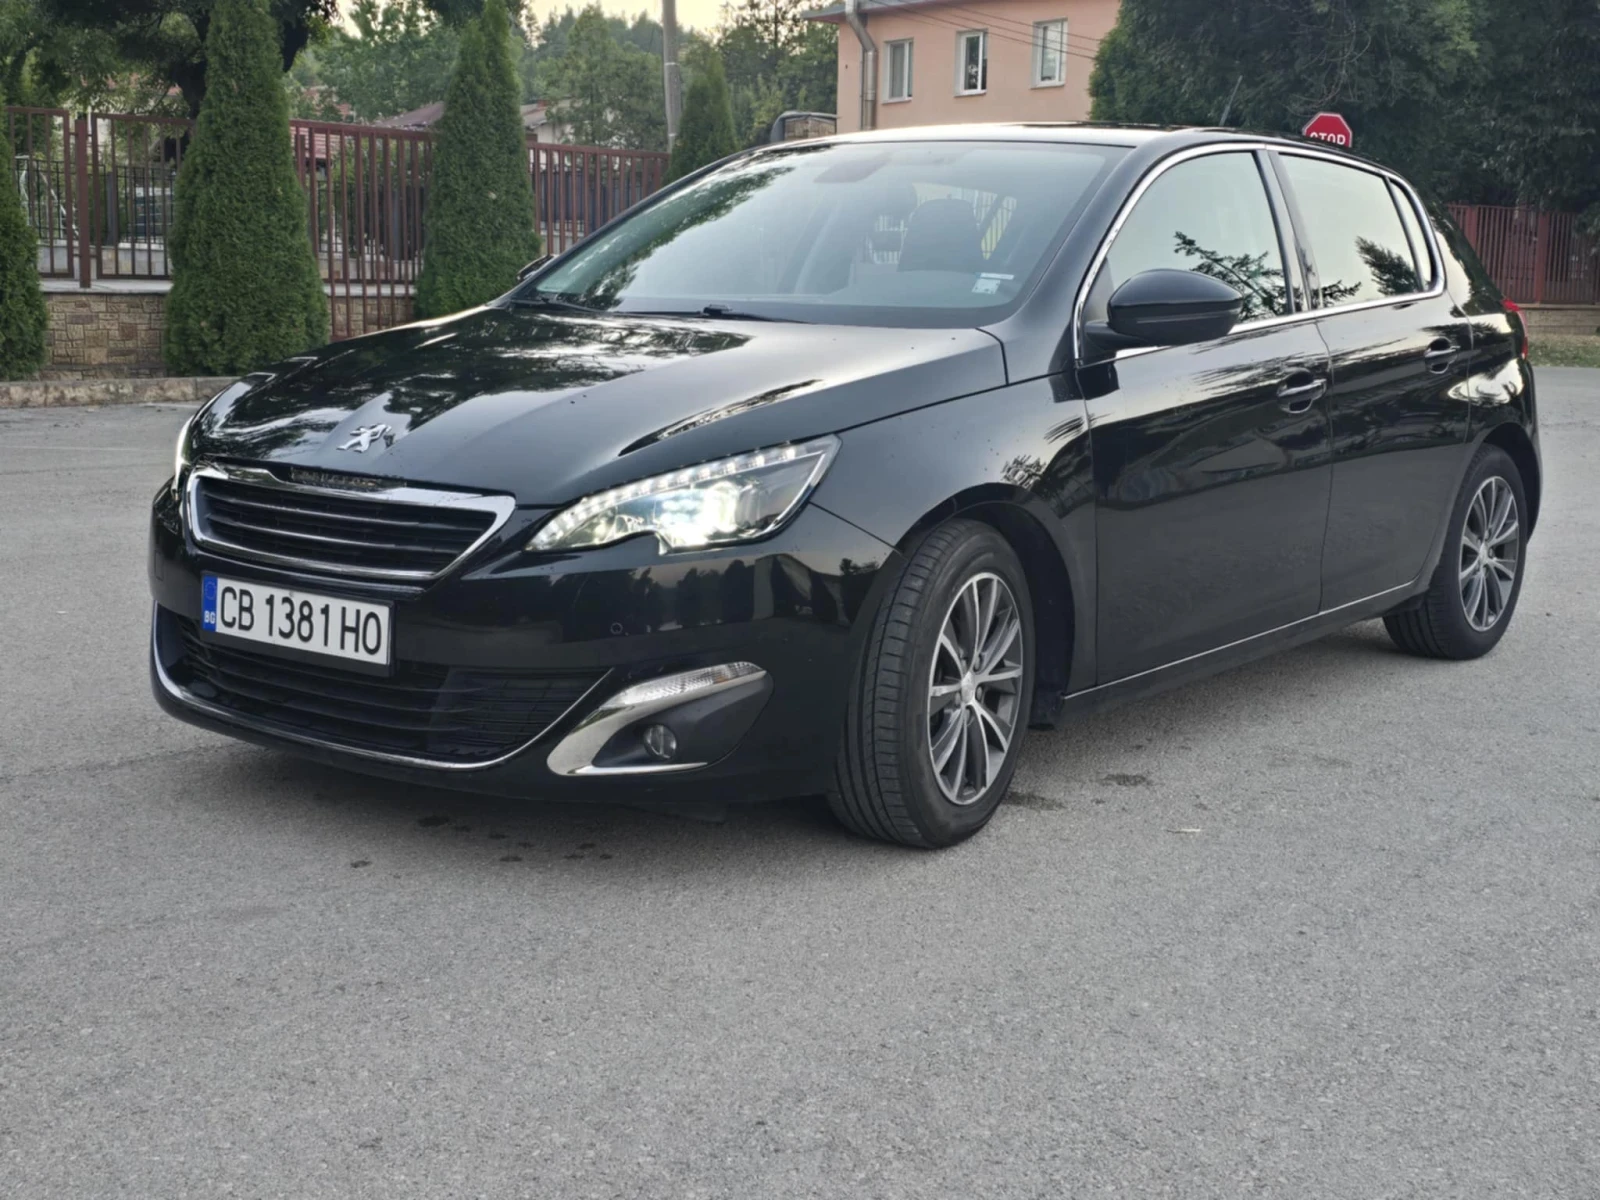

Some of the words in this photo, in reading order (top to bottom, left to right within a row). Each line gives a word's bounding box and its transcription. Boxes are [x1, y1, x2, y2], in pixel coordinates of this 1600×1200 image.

[204, 610, 216, 624] BG
[220, 586, 254, 631] CB
[265, 594, 330, 647] 1381
[340, 606, 382, 655] HO
